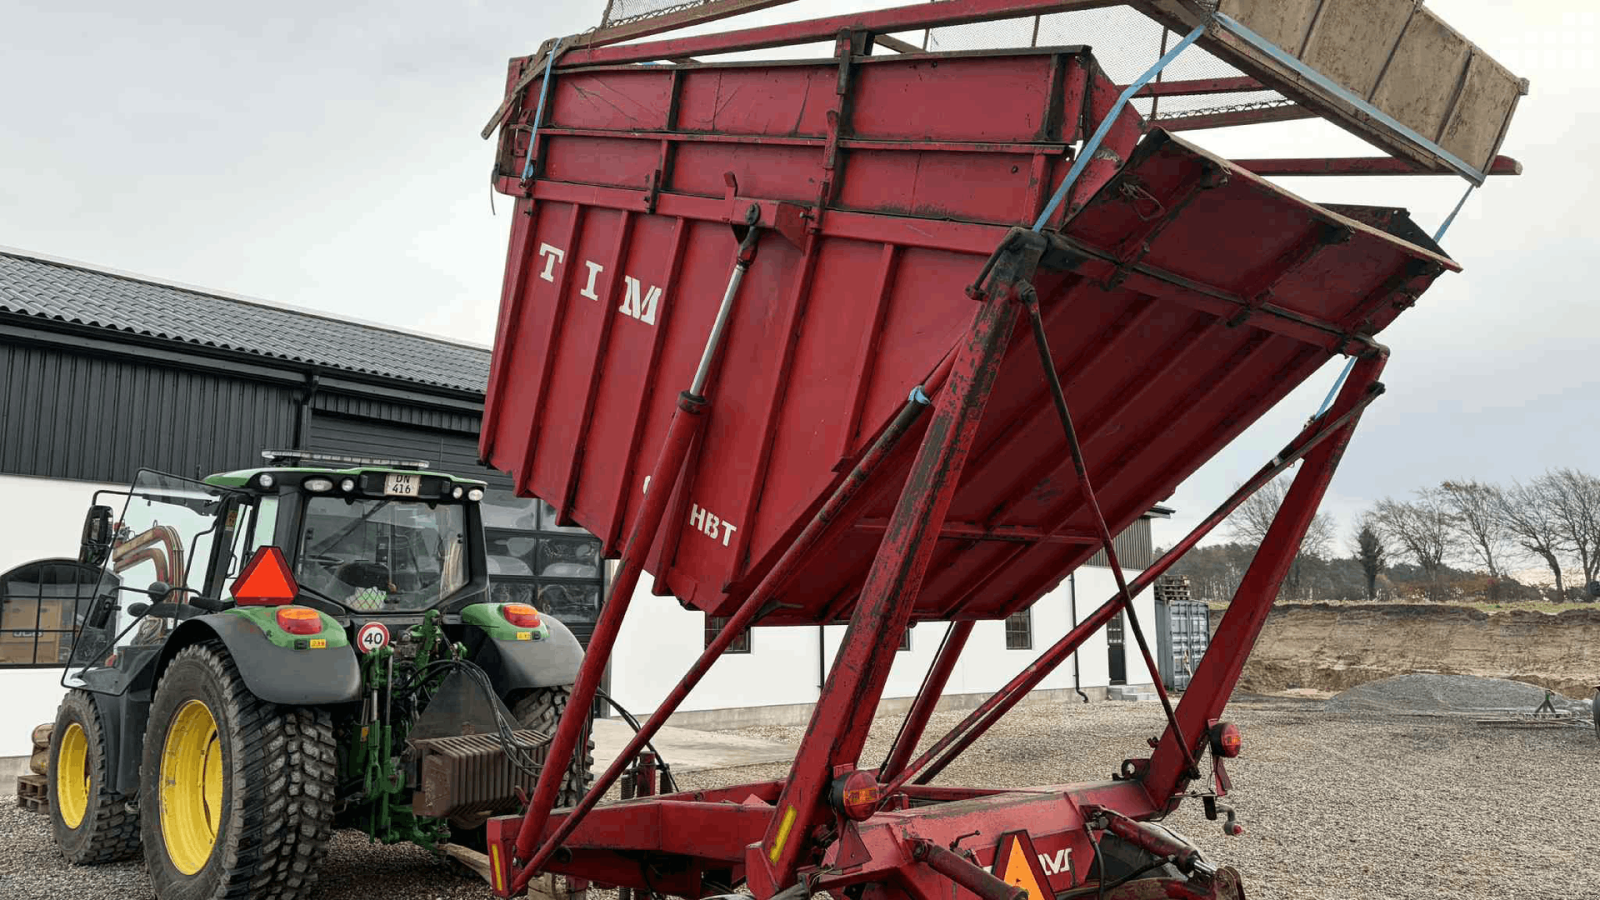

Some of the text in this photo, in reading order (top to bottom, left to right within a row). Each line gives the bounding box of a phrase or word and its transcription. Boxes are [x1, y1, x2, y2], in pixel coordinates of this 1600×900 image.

[395, 474, 410, 483] DN
[392, 484, 411, 494] 416
[689, 503, 737, 547] HBT
[364, 632, 383, 645] 40
